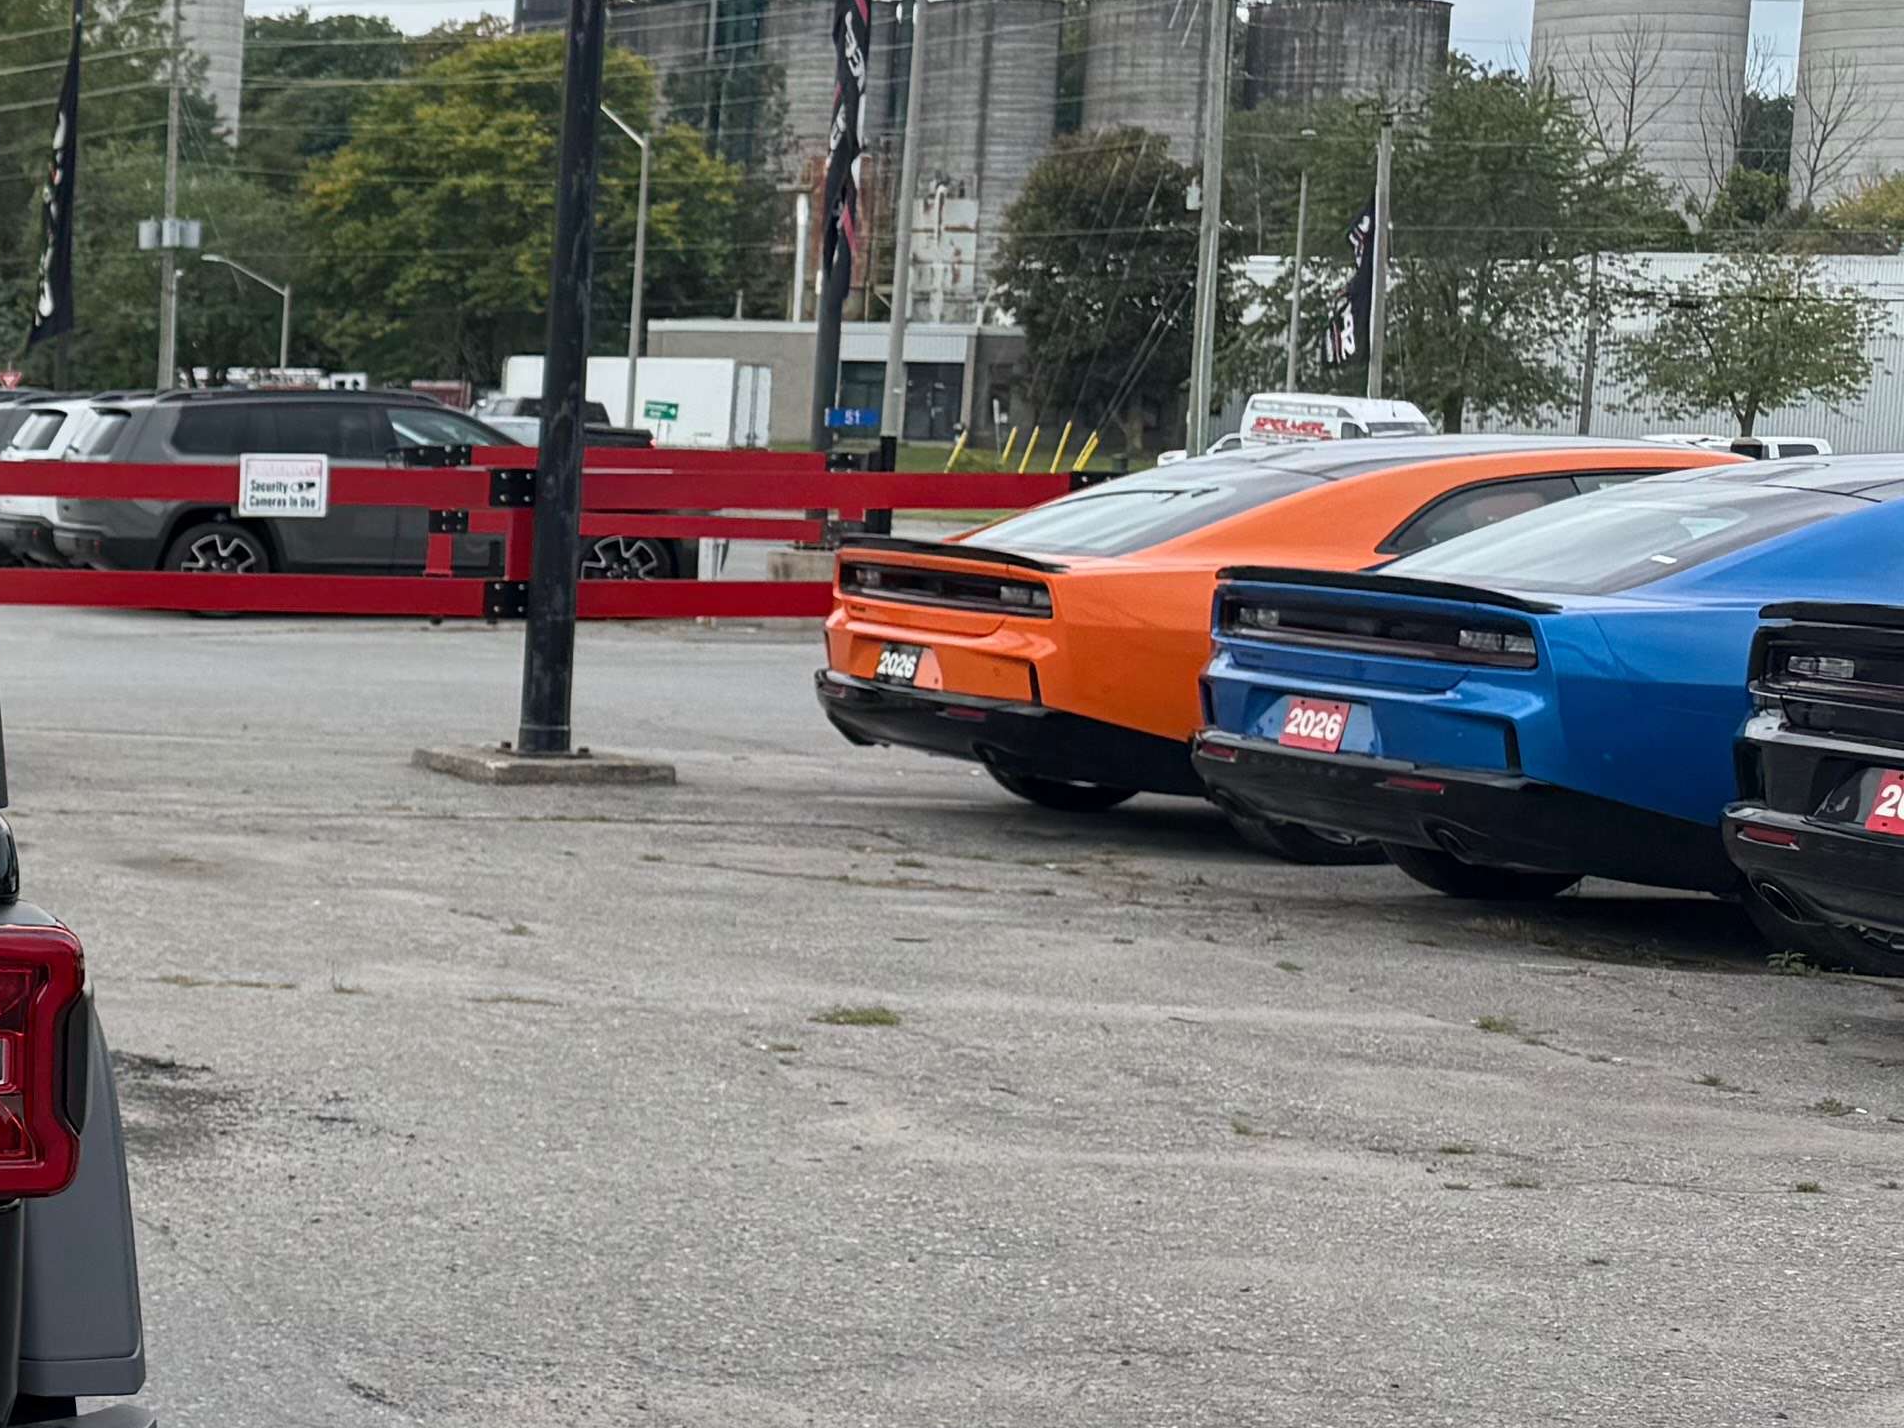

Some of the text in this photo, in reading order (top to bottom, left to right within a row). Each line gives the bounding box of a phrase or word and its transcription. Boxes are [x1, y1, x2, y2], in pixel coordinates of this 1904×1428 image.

[249, 495, 287, 507] Cameras
[250, 479, 288, 494] Security
[876, 650, 918, 679] 2026
[1284, 707, 1343, 741] 2026
[1874, 784, 1904, 821] 2
